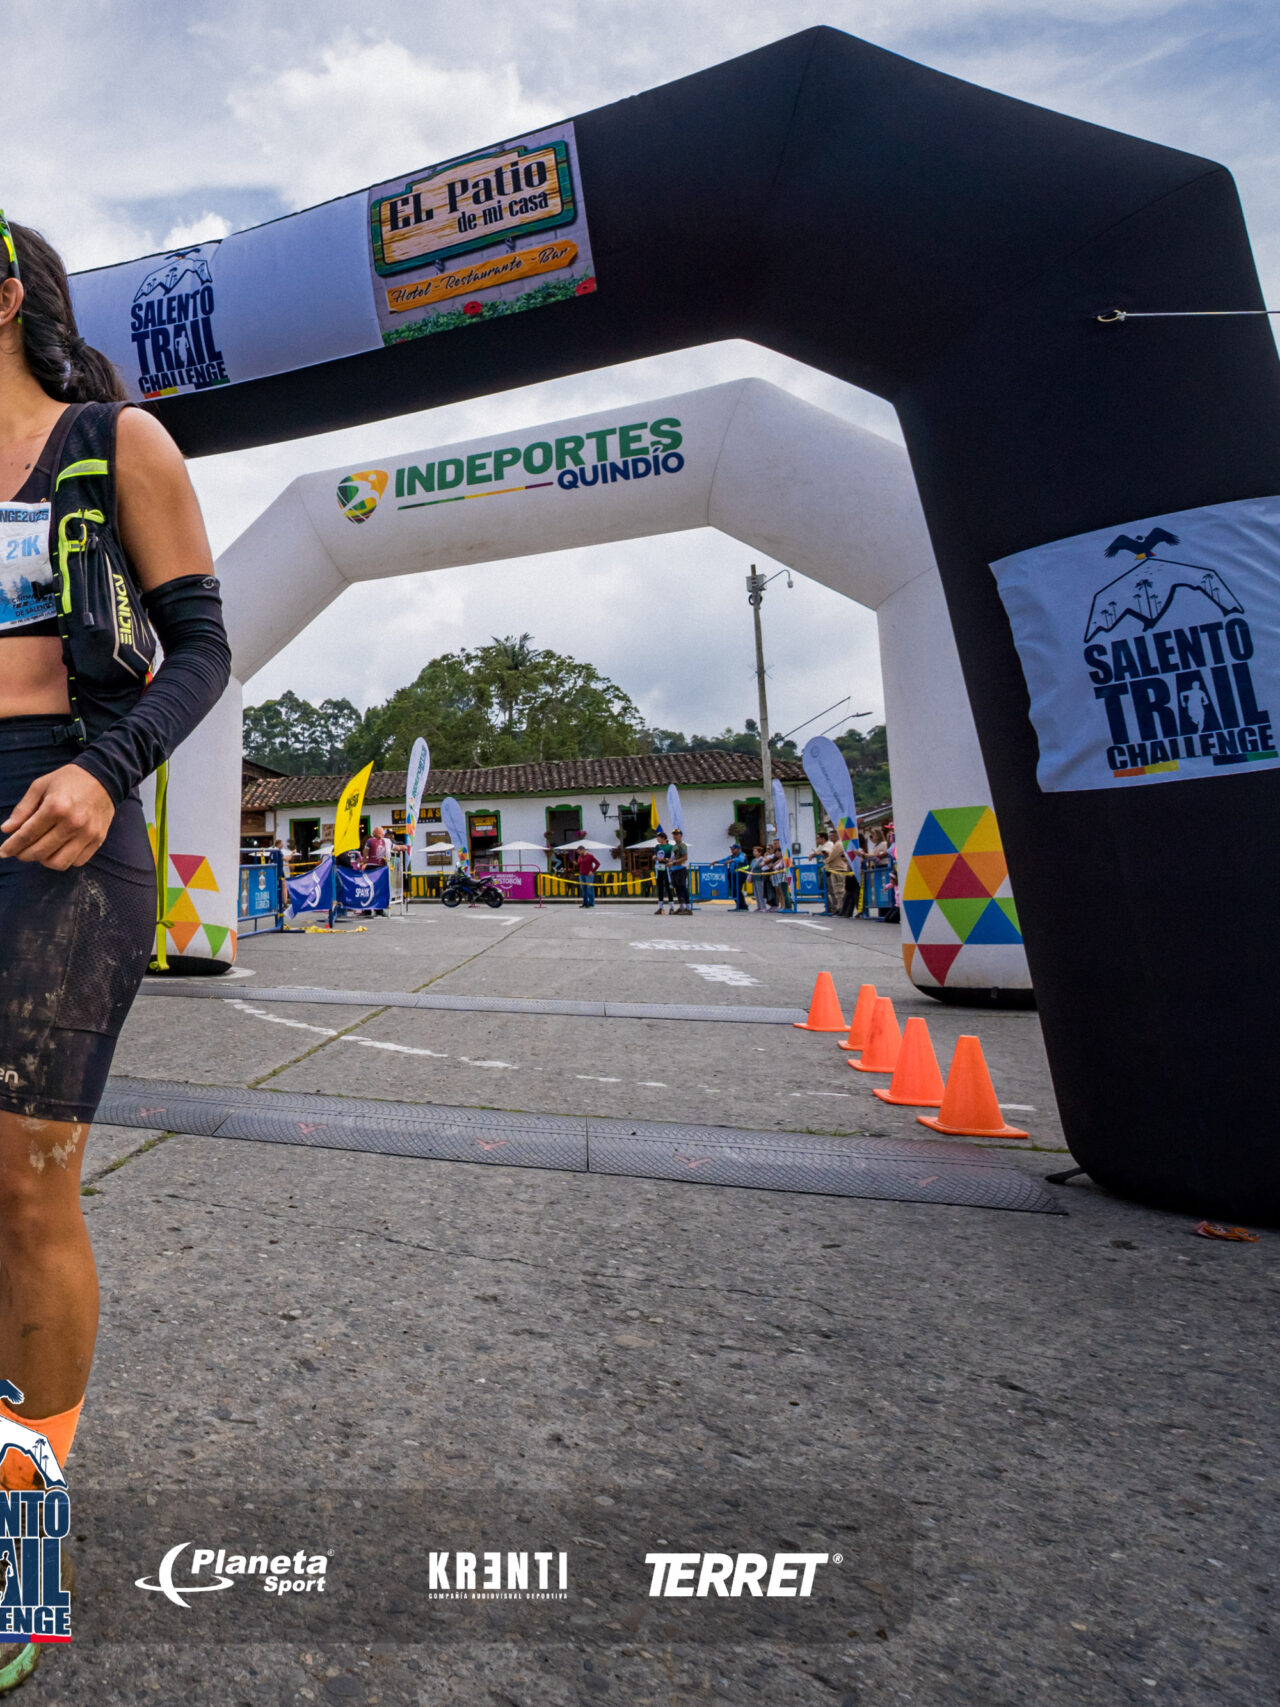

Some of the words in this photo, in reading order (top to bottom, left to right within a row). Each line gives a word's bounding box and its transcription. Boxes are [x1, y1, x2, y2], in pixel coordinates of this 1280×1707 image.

[446, 160, 548, 214] Patio
[457, 211, 477, 233] de
[483, 200, 504, 226] mi
[508, 191, 549, 217] casa
[130, 285, 214, 332] SALENTO
[391, 283, 431, 303] Hotel
[131, 316, 224, 376] TRAIL
[138, 360, 229, 394] CHALLENGE
[395, 417, 683, 498] INDEPORTES
[557, 446, 685, 490] QUINDÍO
[6, 534, 41, 561] 21K
[1083, 617, 1254, 685] SALENTO
[1094, 662, 1270, 745] TRAIL
[1106, 724, 1276, 771] CHALLENGE
